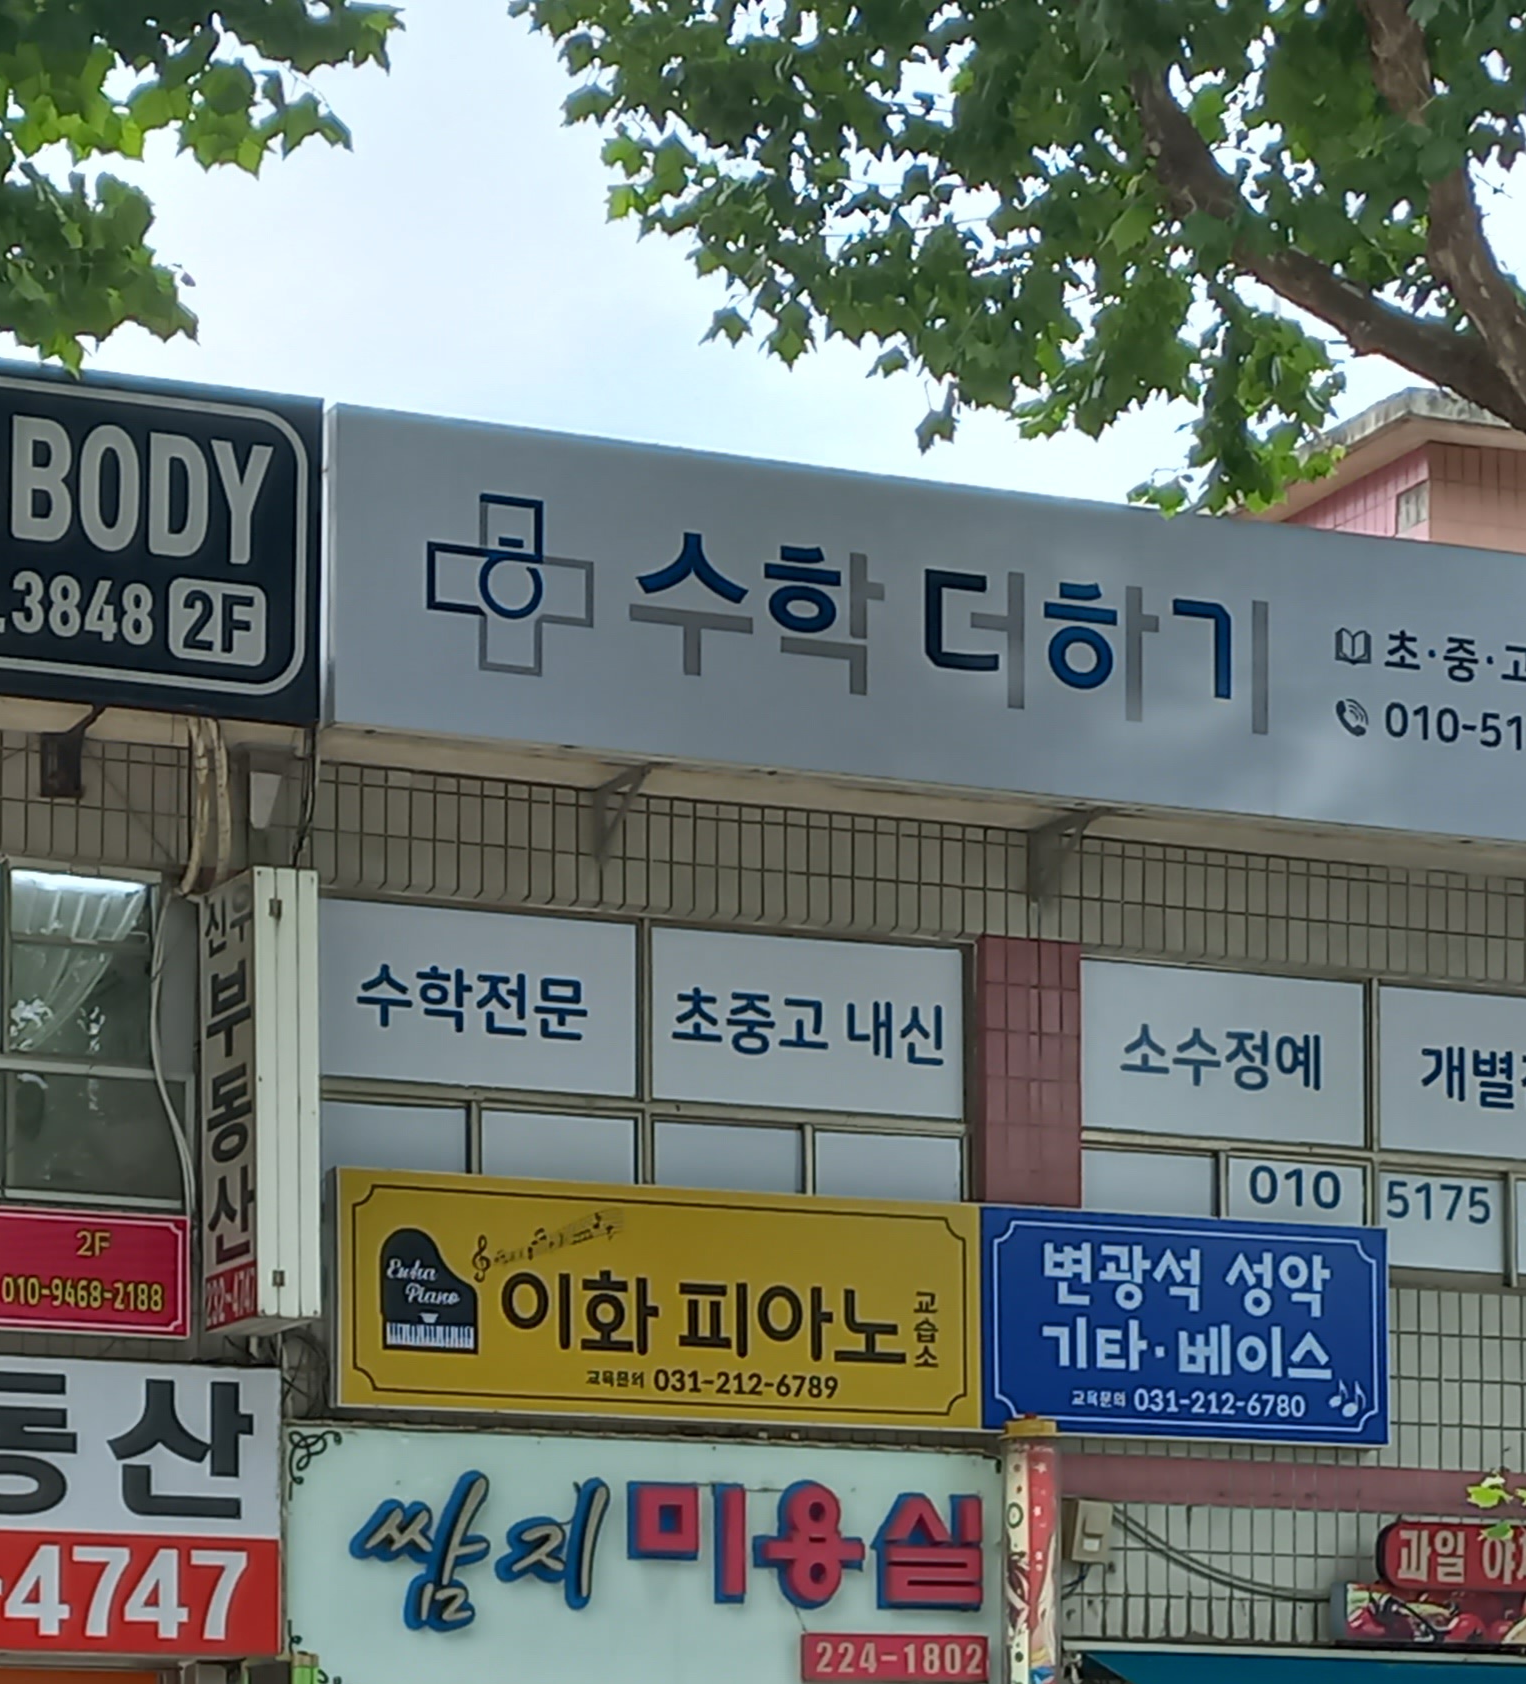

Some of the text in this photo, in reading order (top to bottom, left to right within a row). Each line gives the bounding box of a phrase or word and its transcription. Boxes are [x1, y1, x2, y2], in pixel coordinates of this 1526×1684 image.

[12, 414, 273, 565] BODY
[182, 589, 253, 654] 2F
[629, 533, 1269, 735] 수학 더하기
[205, 883, 251, 953] 신우
[356, 962, 588, 1042] 수학전문
[672, 986, 946, 1066] 초중고 내신
[1118, 1022, 1323, 1092] 소수정예
[205, 959, 255, 1265] 부동산
[1248, 1164, 1342, 1212] 010
[1385, 1180, 1491, 1228] 5175
[76, 1228, 111, 1258] 2F
[0, 1274, 163, 1314] 010-9468-2188
[405, 1283, 460, 1306] Piano
[1043, 1242, 1331, 1318] 변광석 성악
[501, 1270, 907, 1368] 이화 피아노
[915, 1291, 938, 1369] 교습소
[653, 1368, 838, 1400] 031-212-6789
[1134, 1388, 1305, 1417] 031-212-6780
[350, 1470, 985, 1631] 쌈지 미용실
[1398, 1528, 1465, 1583] 과일
[815, 1640, 982, 1675] 224-1802
